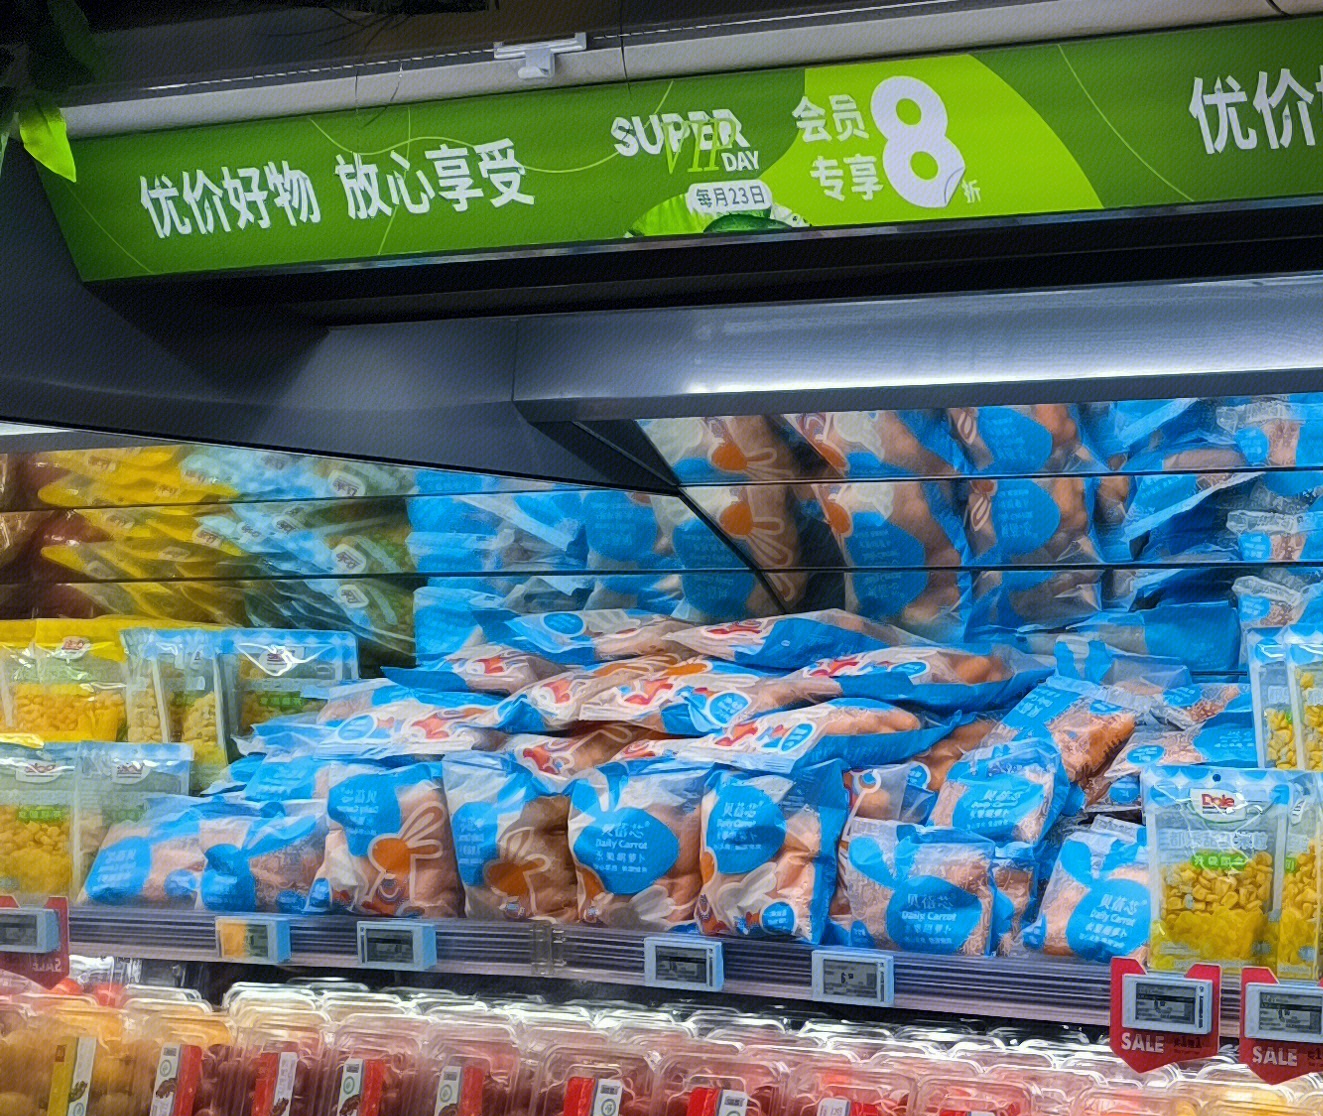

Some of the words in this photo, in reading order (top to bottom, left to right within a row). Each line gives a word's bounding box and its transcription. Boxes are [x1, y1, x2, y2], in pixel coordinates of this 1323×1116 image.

[792, 92, 867, 143] 会员
[610, 107, 750, 160] SUPER
[869, 74, 966, 210] 8
[720, 149, 761, 174] DAY
[139, 160, 320, 241] 优价好物
[335, 137, 536, 221] 放心享受
[809, 152, 884, 203] 专享
[959, 177, 982, 205] 折
[694, 182, 767, 210] 每月23日
[1200, 793, 1236, 808] Dole
[618, 838, 648, 850] Carrot
[926, 910, 957, 922] Carrot
[1120, 1031, 1165, 1053] SALE
[1251, 1045, 1298, 1067] SALE
